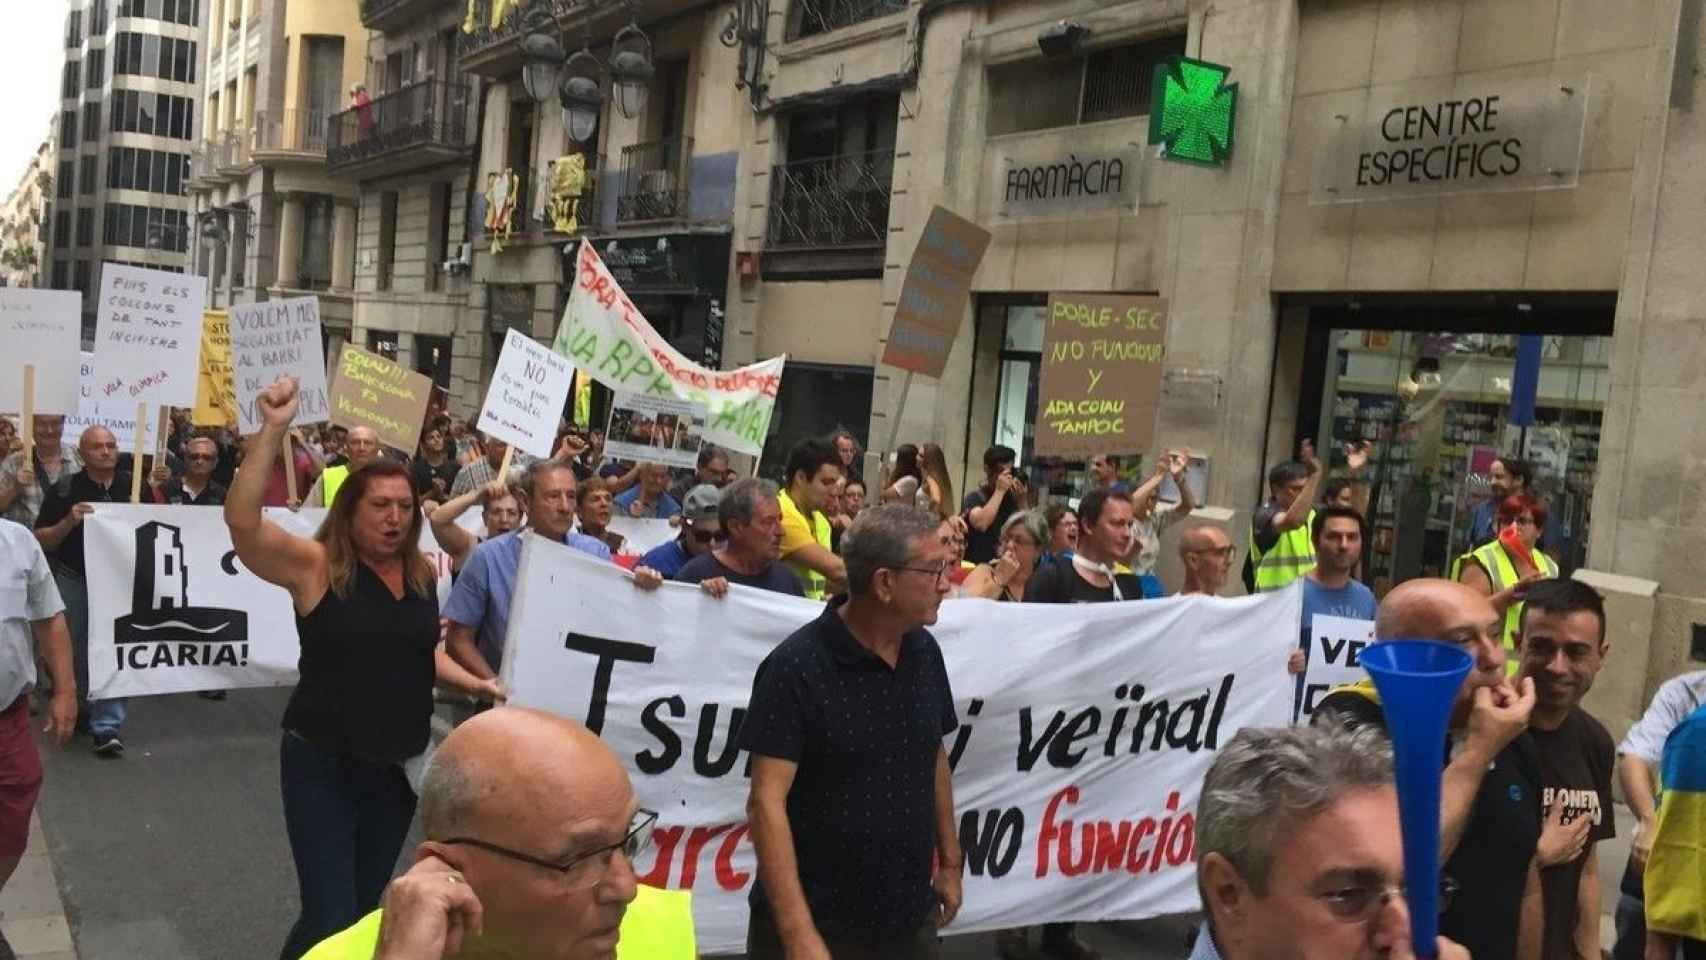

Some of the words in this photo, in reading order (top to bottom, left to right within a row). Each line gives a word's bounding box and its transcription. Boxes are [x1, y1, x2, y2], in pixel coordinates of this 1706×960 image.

[1381, 95, 1500, 142] CENTRE
[1356, 137, 1522, 186] ESPECÍFICS
[1006, 153, 1124, 201] FARMÀCIA
[236, 304, 289, 330] VOLEM
[1051, 340, 1084, 363] NO
[523, 359, 547, 385] NO
[1087, 368, 1103, 394] Y
[1043, 400, 1075, 419] ADA
[1050, 417, 1125, 435] TAMPOC
[1016, 673, 1235, 772] veïnal
[959, 806, 1024, 879] NO
